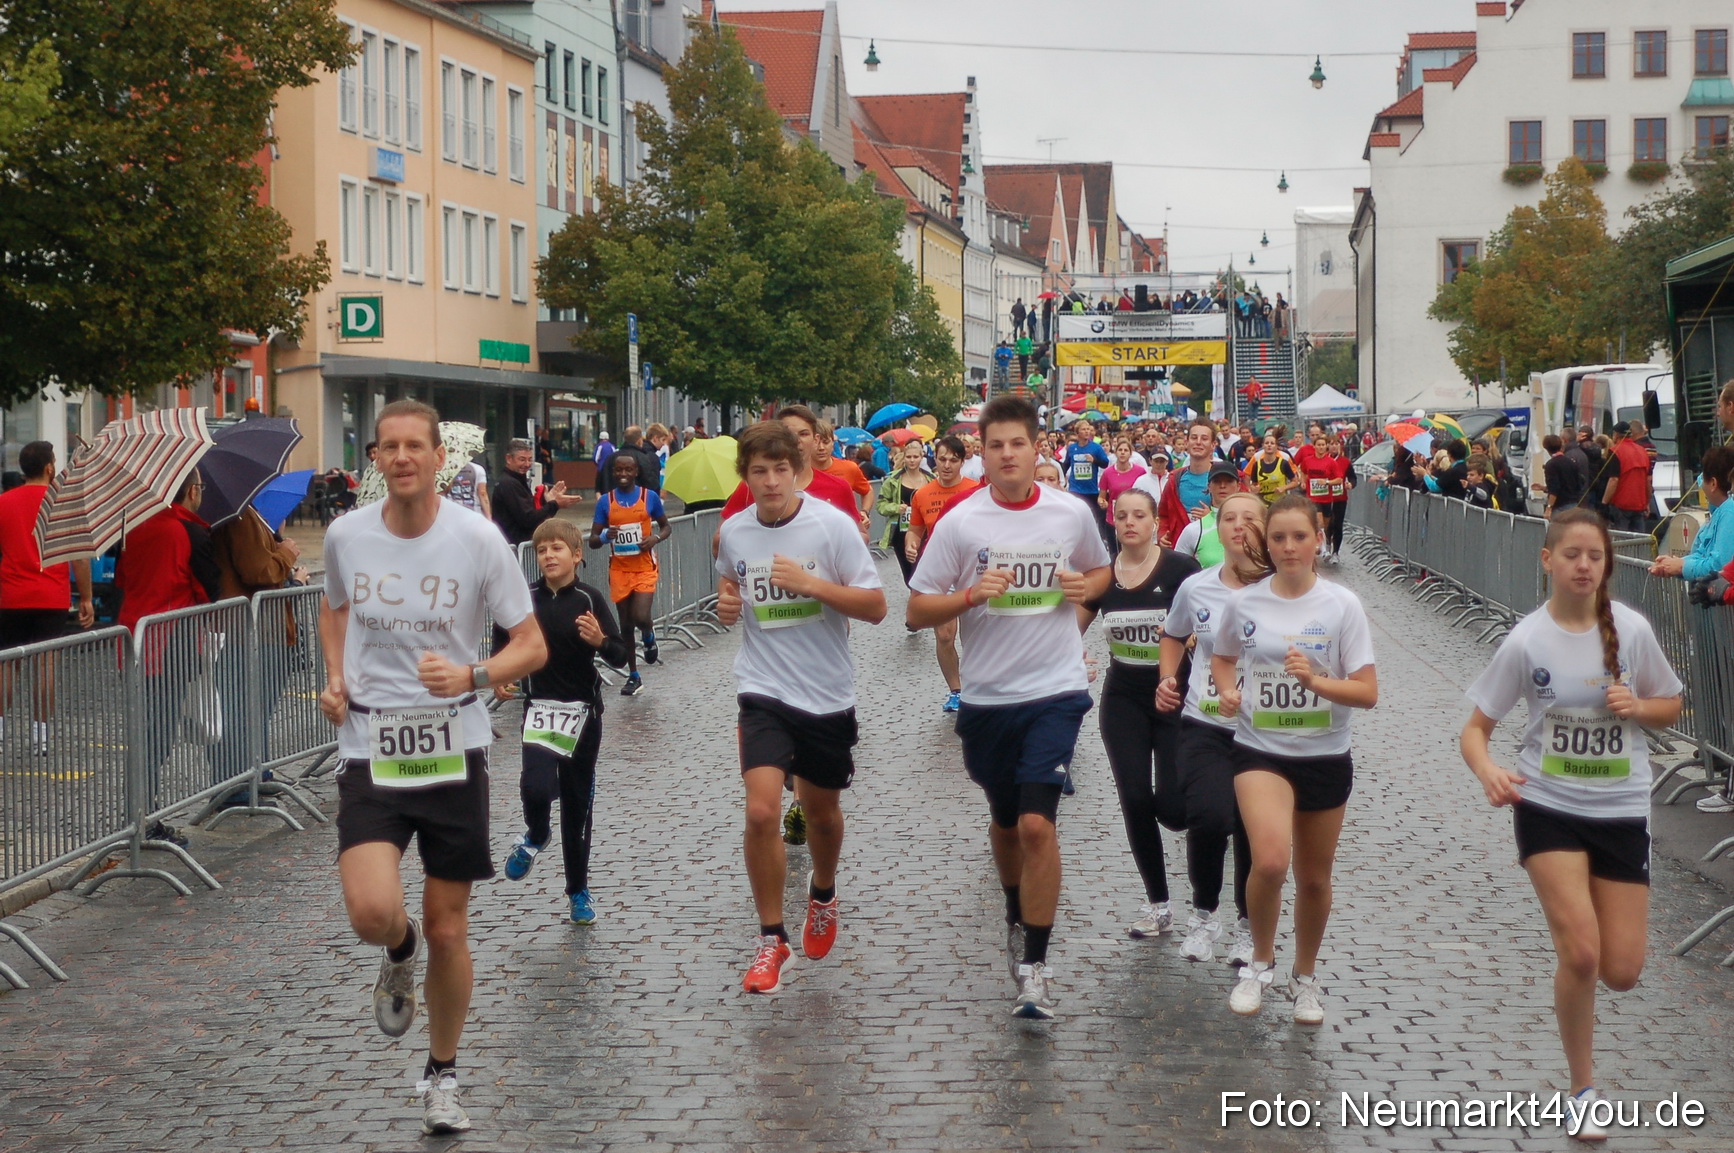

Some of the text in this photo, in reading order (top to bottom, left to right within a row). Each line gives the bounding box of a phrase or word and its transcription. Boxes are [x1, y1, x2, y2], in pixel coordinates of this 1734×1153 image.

[347, 303, 376, 332] D
[1111, 346, 1170, 361] START
[747, 566, 769, 574] PARTL
[353, 572, 460, 610] BC 93
[754, 577, 812, 602] 50
[1010, 595, 1042, 606] Tobias
[768, 607, 802, 618] Florian
[355, 612, 456, 633] Neumarkt
[1110, 625, 1160, 643] 5003
[1127, 647, 1148, 659] Tanja
[1253, 671, 1277, 679] PARTL
[371, 711, 444, 722] PARTL Neumarkt
[532, 711, 581, 735] 5172
[1278, 715, 1304, 726] Lena
[1545, 712, 1617, 724] PARTL Neumarkt
[379, 721, 451, 756] 5051
[1551, 724, 1624, 756] 5038
[399, 761, 439, 775] Robert
[1563, 761, 1610, 775] Barbara
